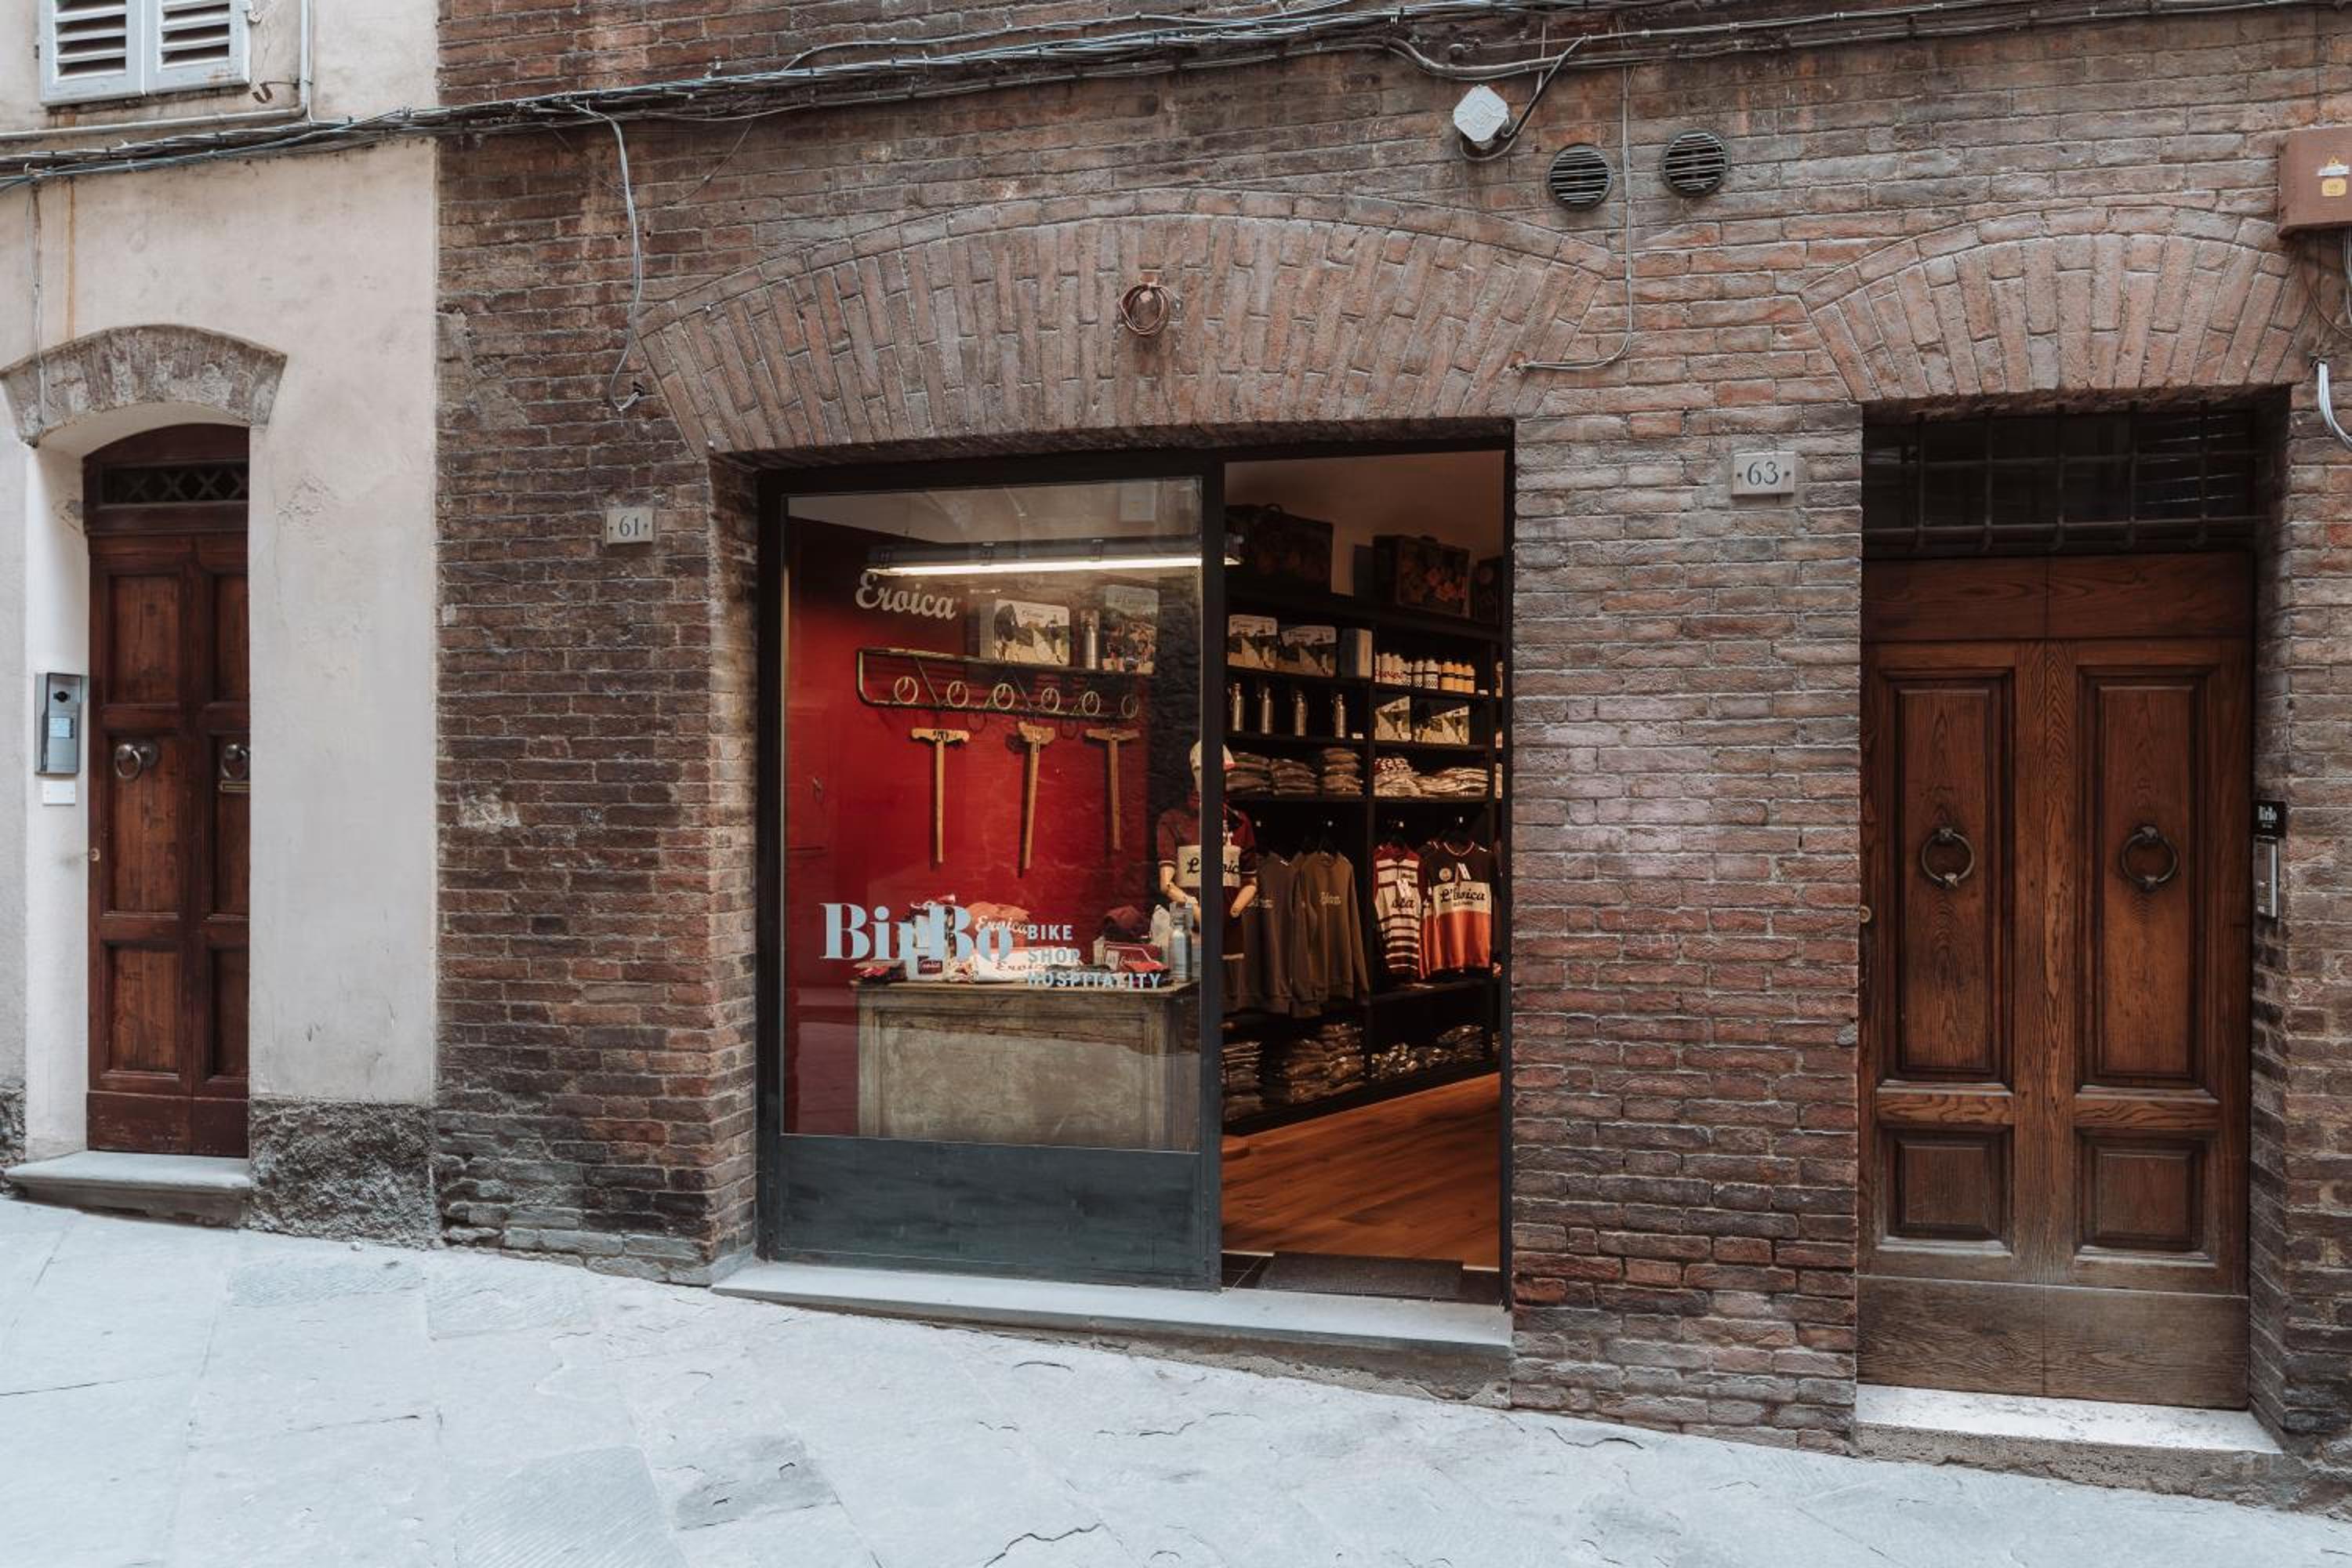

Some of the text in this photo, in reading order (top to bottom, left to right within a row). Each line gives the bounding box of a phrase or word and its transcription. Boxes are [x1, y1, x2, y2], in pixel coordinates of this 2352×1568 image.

[1747, 460, 1779, 485] 63
[619, 515, 639, 537] 61
[855, 571, 956, 620] Eroica
[1028, 924, 1073, 940] BIKE
[1029, 948, 1080, 964] SHOP
[1028, 971, 1161, 989] HOSPITALITY
